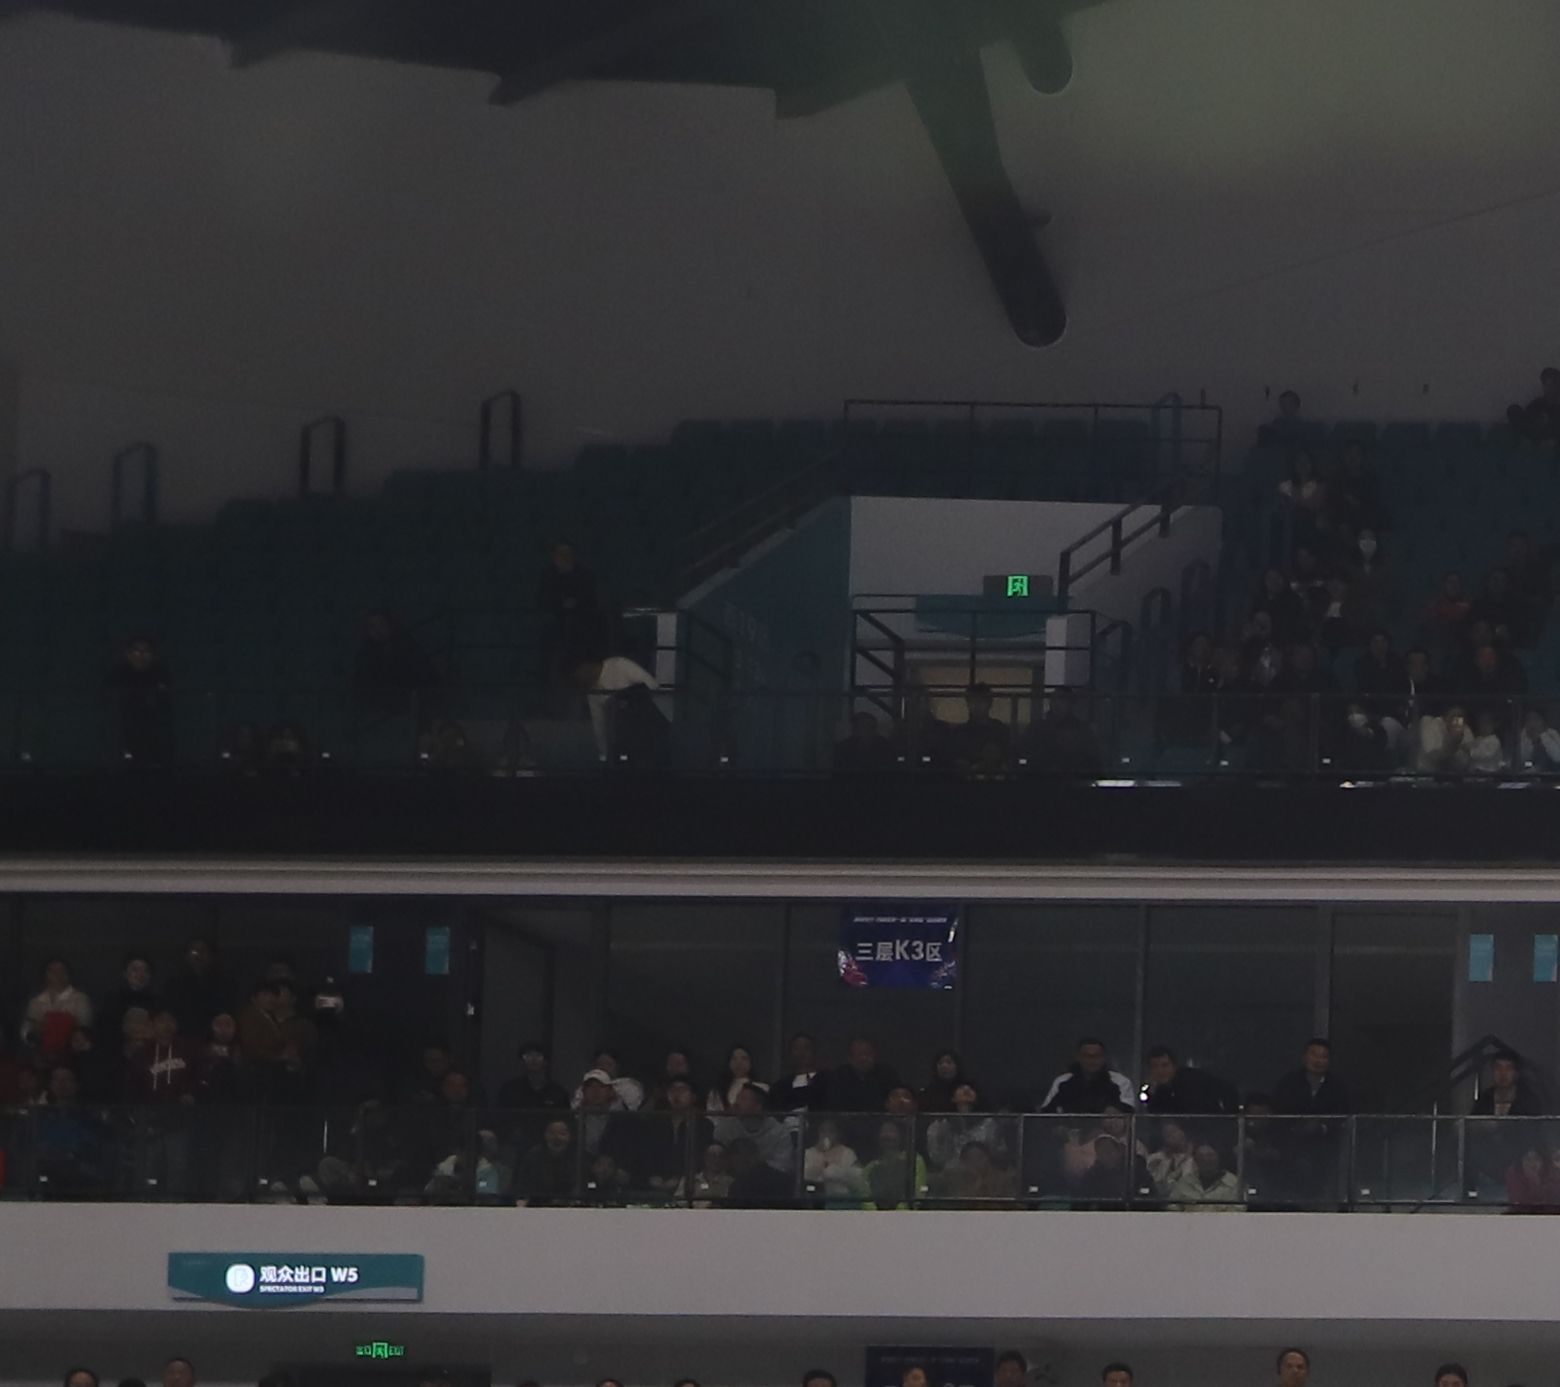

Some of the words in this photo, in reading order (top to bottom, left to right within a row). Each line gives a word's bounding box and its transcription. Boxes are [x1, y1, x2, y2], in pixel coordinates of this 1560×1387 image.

[855, 940, 943, 962] 三层K3区
[259, 1265, 326, 1283] 观众出口
[331, 1267, 359, 1282] W5
